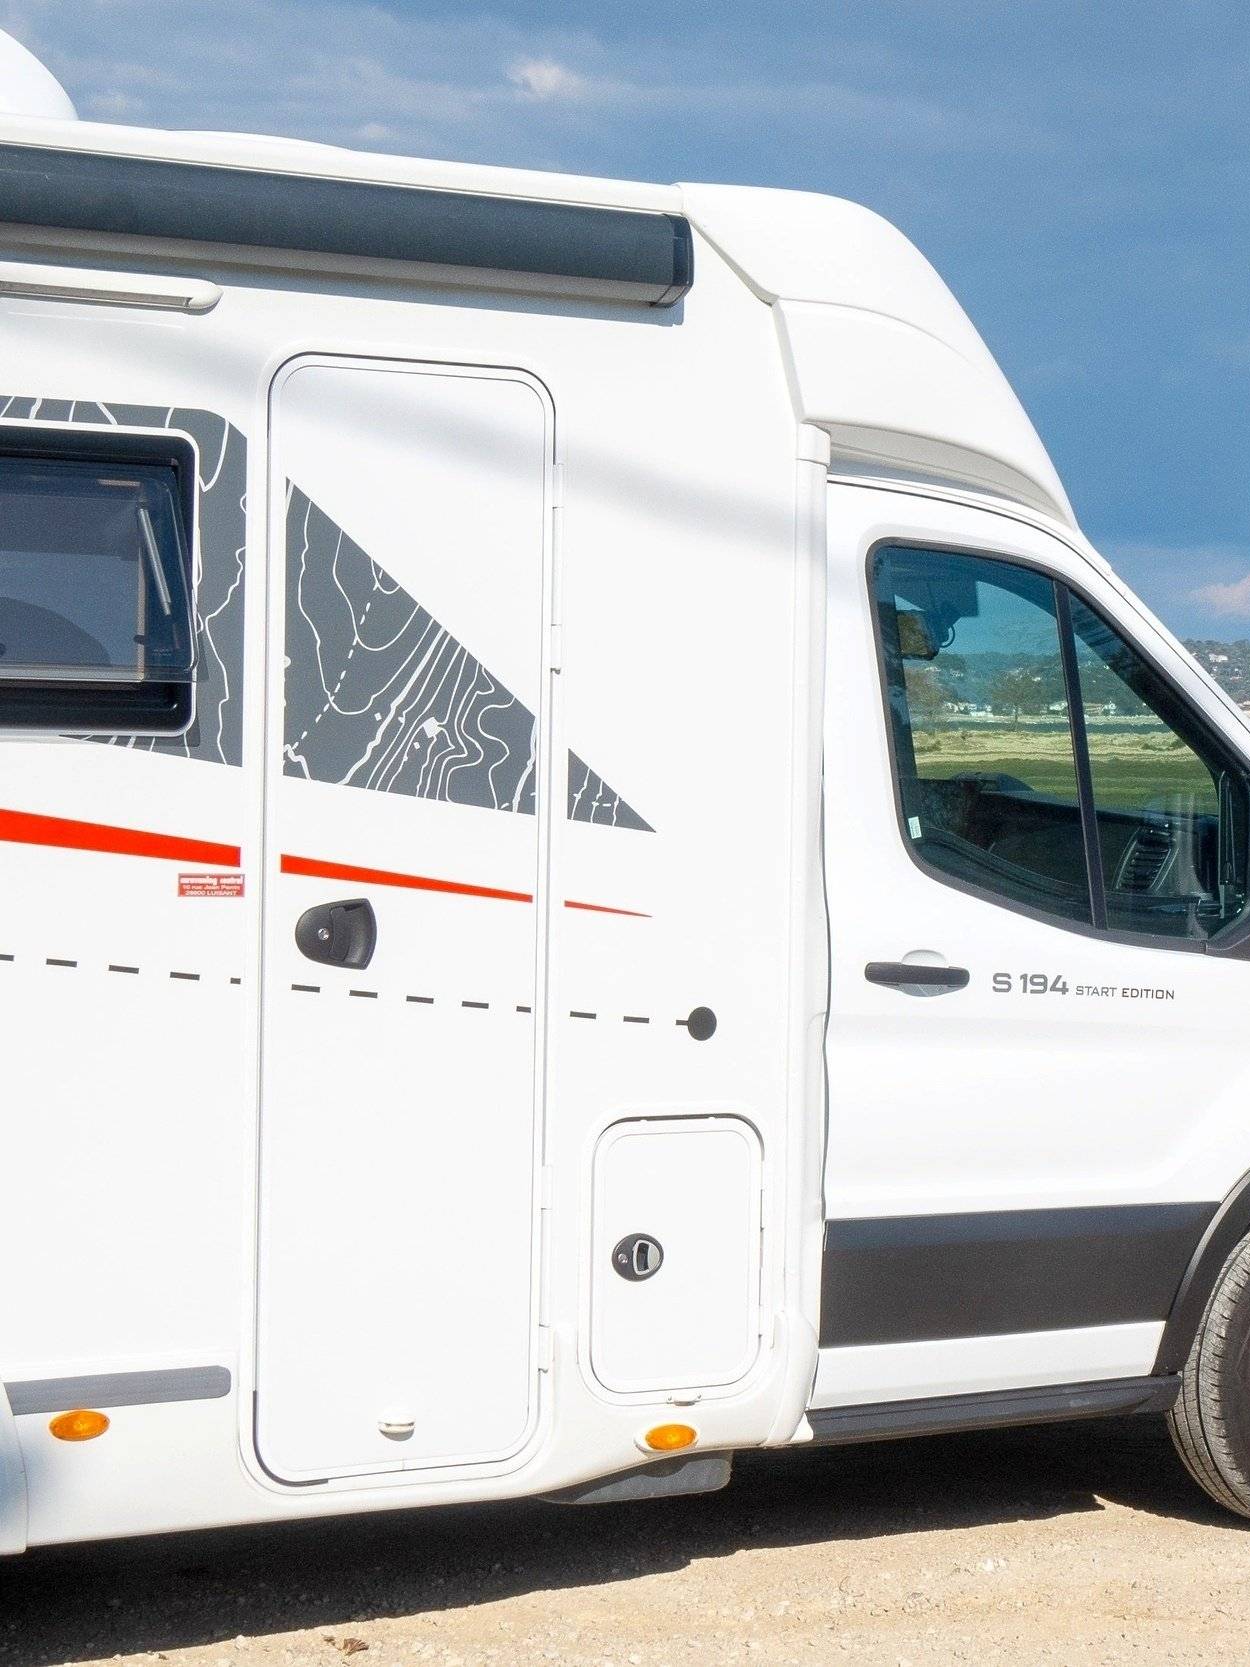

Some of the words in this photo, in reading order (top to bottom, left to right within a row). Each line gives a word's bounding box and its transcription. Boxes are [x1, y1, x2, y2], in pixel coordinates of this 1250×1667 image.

[992, 972, 1012, 993] S
[1019, 973, 1070, 996] 194
[1075, 985, 1117, 998] START
[1121, 987, 1175, 1000] EDITION
